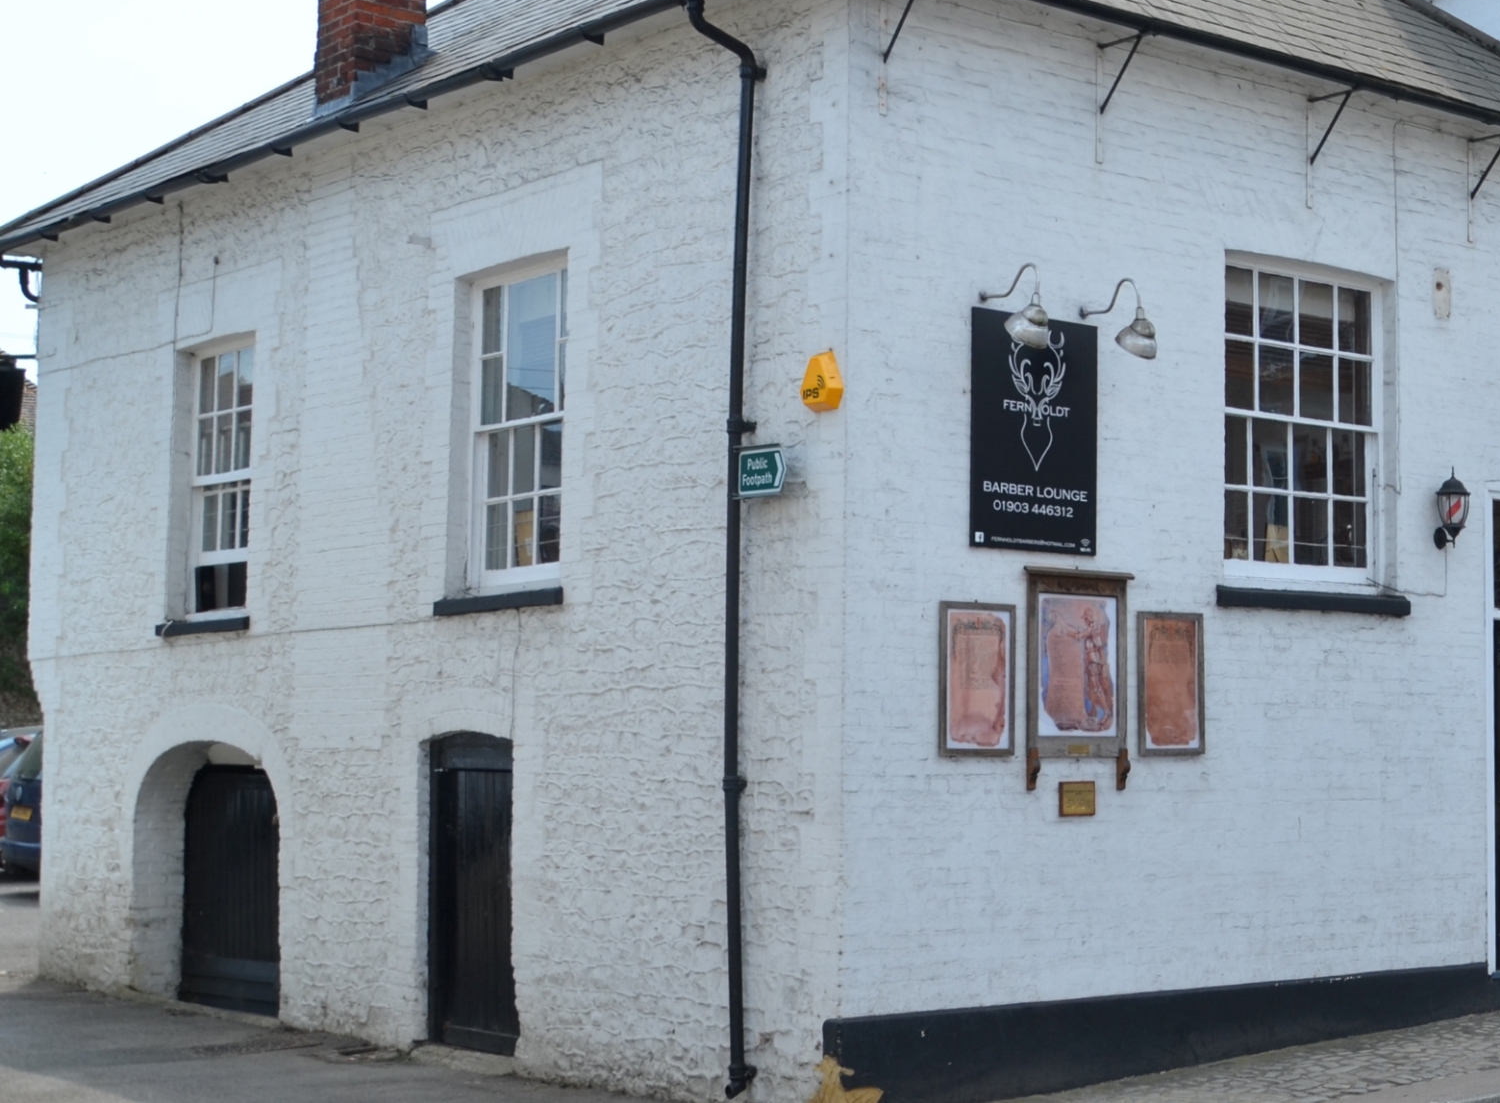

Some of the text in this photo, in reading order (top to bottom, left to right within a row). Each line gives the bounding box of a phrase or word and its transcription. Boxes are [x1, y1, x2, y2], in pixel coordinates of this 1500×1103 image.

[802, 387, 820, 400] IPS
[747, 457, 769, 471] Public
[742, 471, 773, 487] Footpath
[983, 481, 1088, 503] BARBER LOUNGE
[993, 499, 1074, 518] 01903 446312
